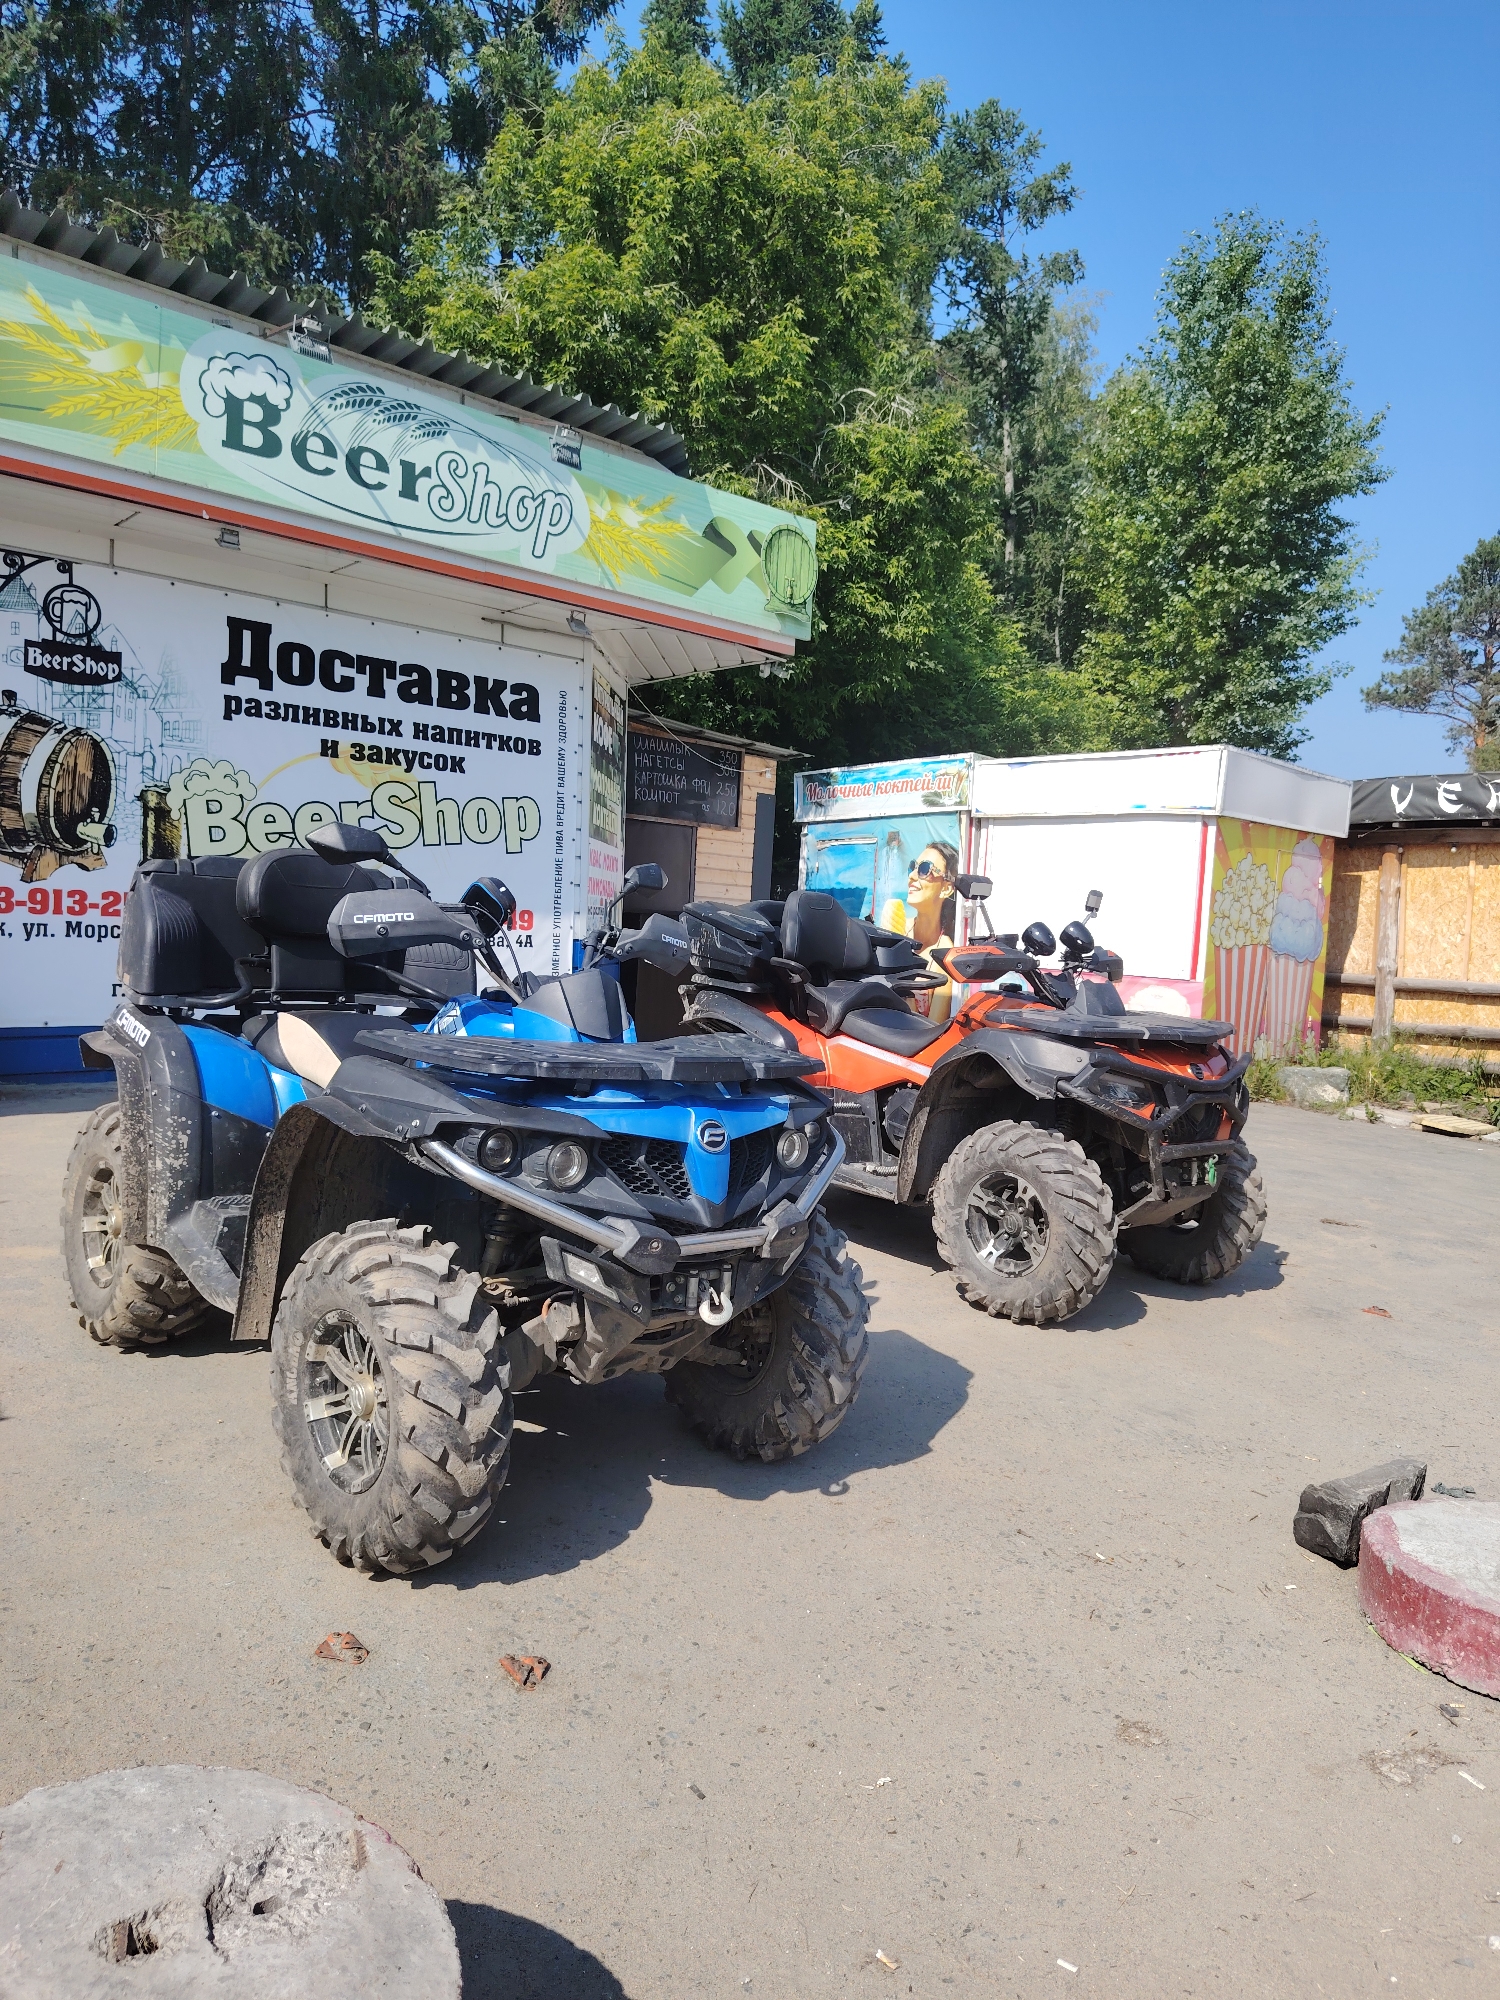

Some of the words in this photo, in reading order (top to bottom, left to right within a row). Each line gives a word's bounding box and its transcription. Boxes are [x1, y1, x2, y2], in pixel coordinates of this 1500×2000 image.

[27, 646, 119, 680] BeerShop
[220, 615, 541, 723] Доставка
[223, 694, 402, 738] разливных
[413, 721, 542, 756] напитков
[558, 690, 568, 744] ЗДОРОВЬЮ
[320, 738, 339, 758] и
[350, 742, 466, 774] закусок
[557, 747, 566, 788] ВАШЕМУ
[635, 753, 685, 770] НАГЕТСЫ
[719, 750, 738, 765] 350
[635, 770, 687, 790] КАРТОШКА
[691, 777, 711, 796] ФРИ
[716, 781, 737, 797] 250
[806, 781, 874, 801] Молочные
[875, 773, 952, 796] коктейли
[556, 790, 566, 827] ВРЕДИТ
[634, 786, 680, 804] КОМПОТ
[716, 799, 736, 817] 120
[556, 829, 564, 855] ПИВА
[553, 857, 564, 930] УПОТРЕБЛЕНИЕ
[22, 922, 55, 942] ул.
[353, 912, 415, 924] CFMOTO
[661, 933, 688, 949] CFMOTO
[116, 1008, 152, 1048] CFMOTO
